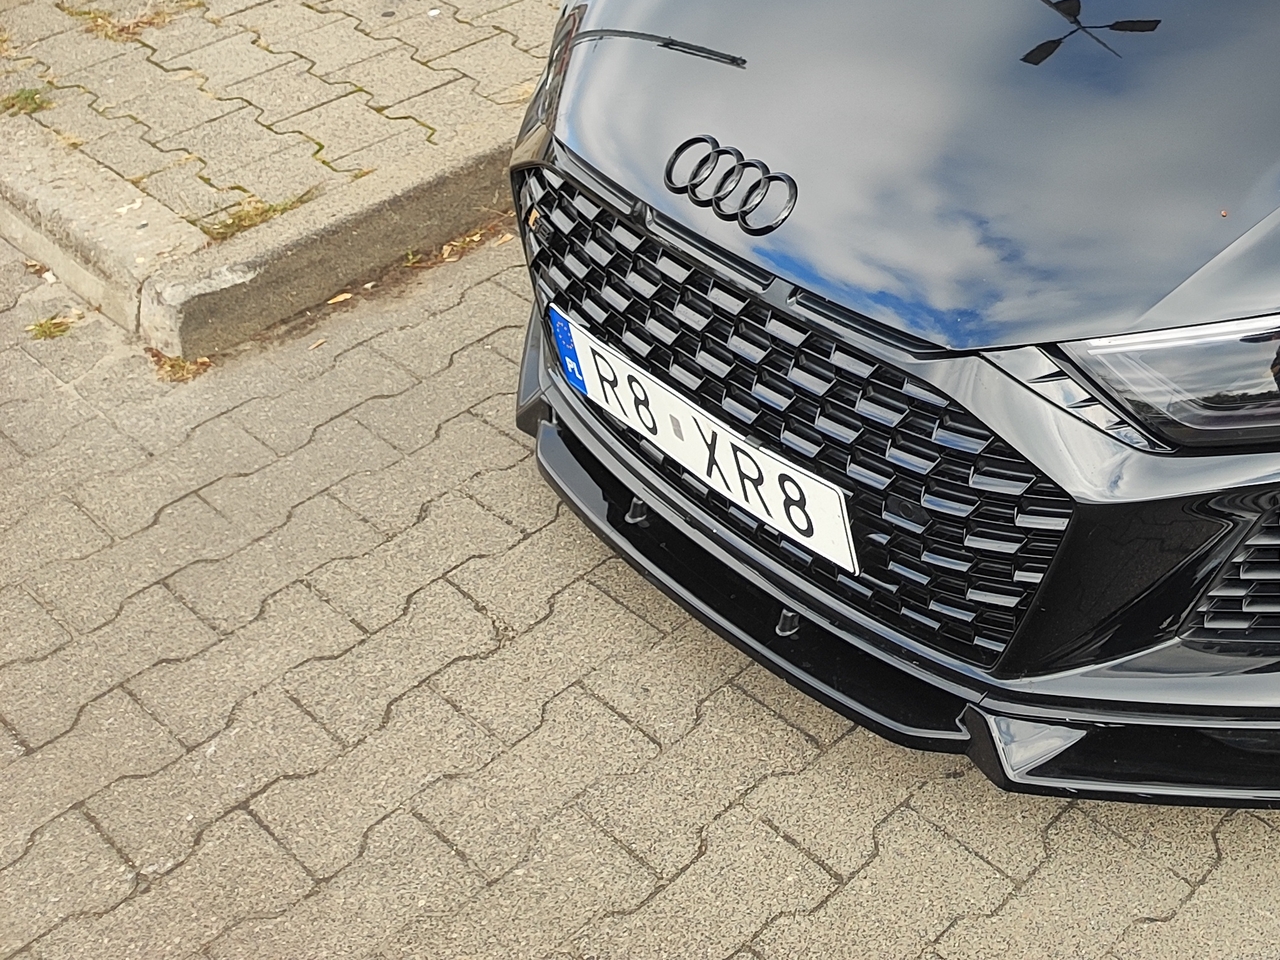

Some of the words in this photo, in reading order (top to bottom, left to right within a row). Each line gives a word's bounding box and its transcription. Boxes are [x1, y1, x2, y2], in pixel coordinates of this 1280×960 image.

[566, 356, 583, 381] PL
[589, 345, 658, 437] R8
[691, 415, 814, 539] XR8
